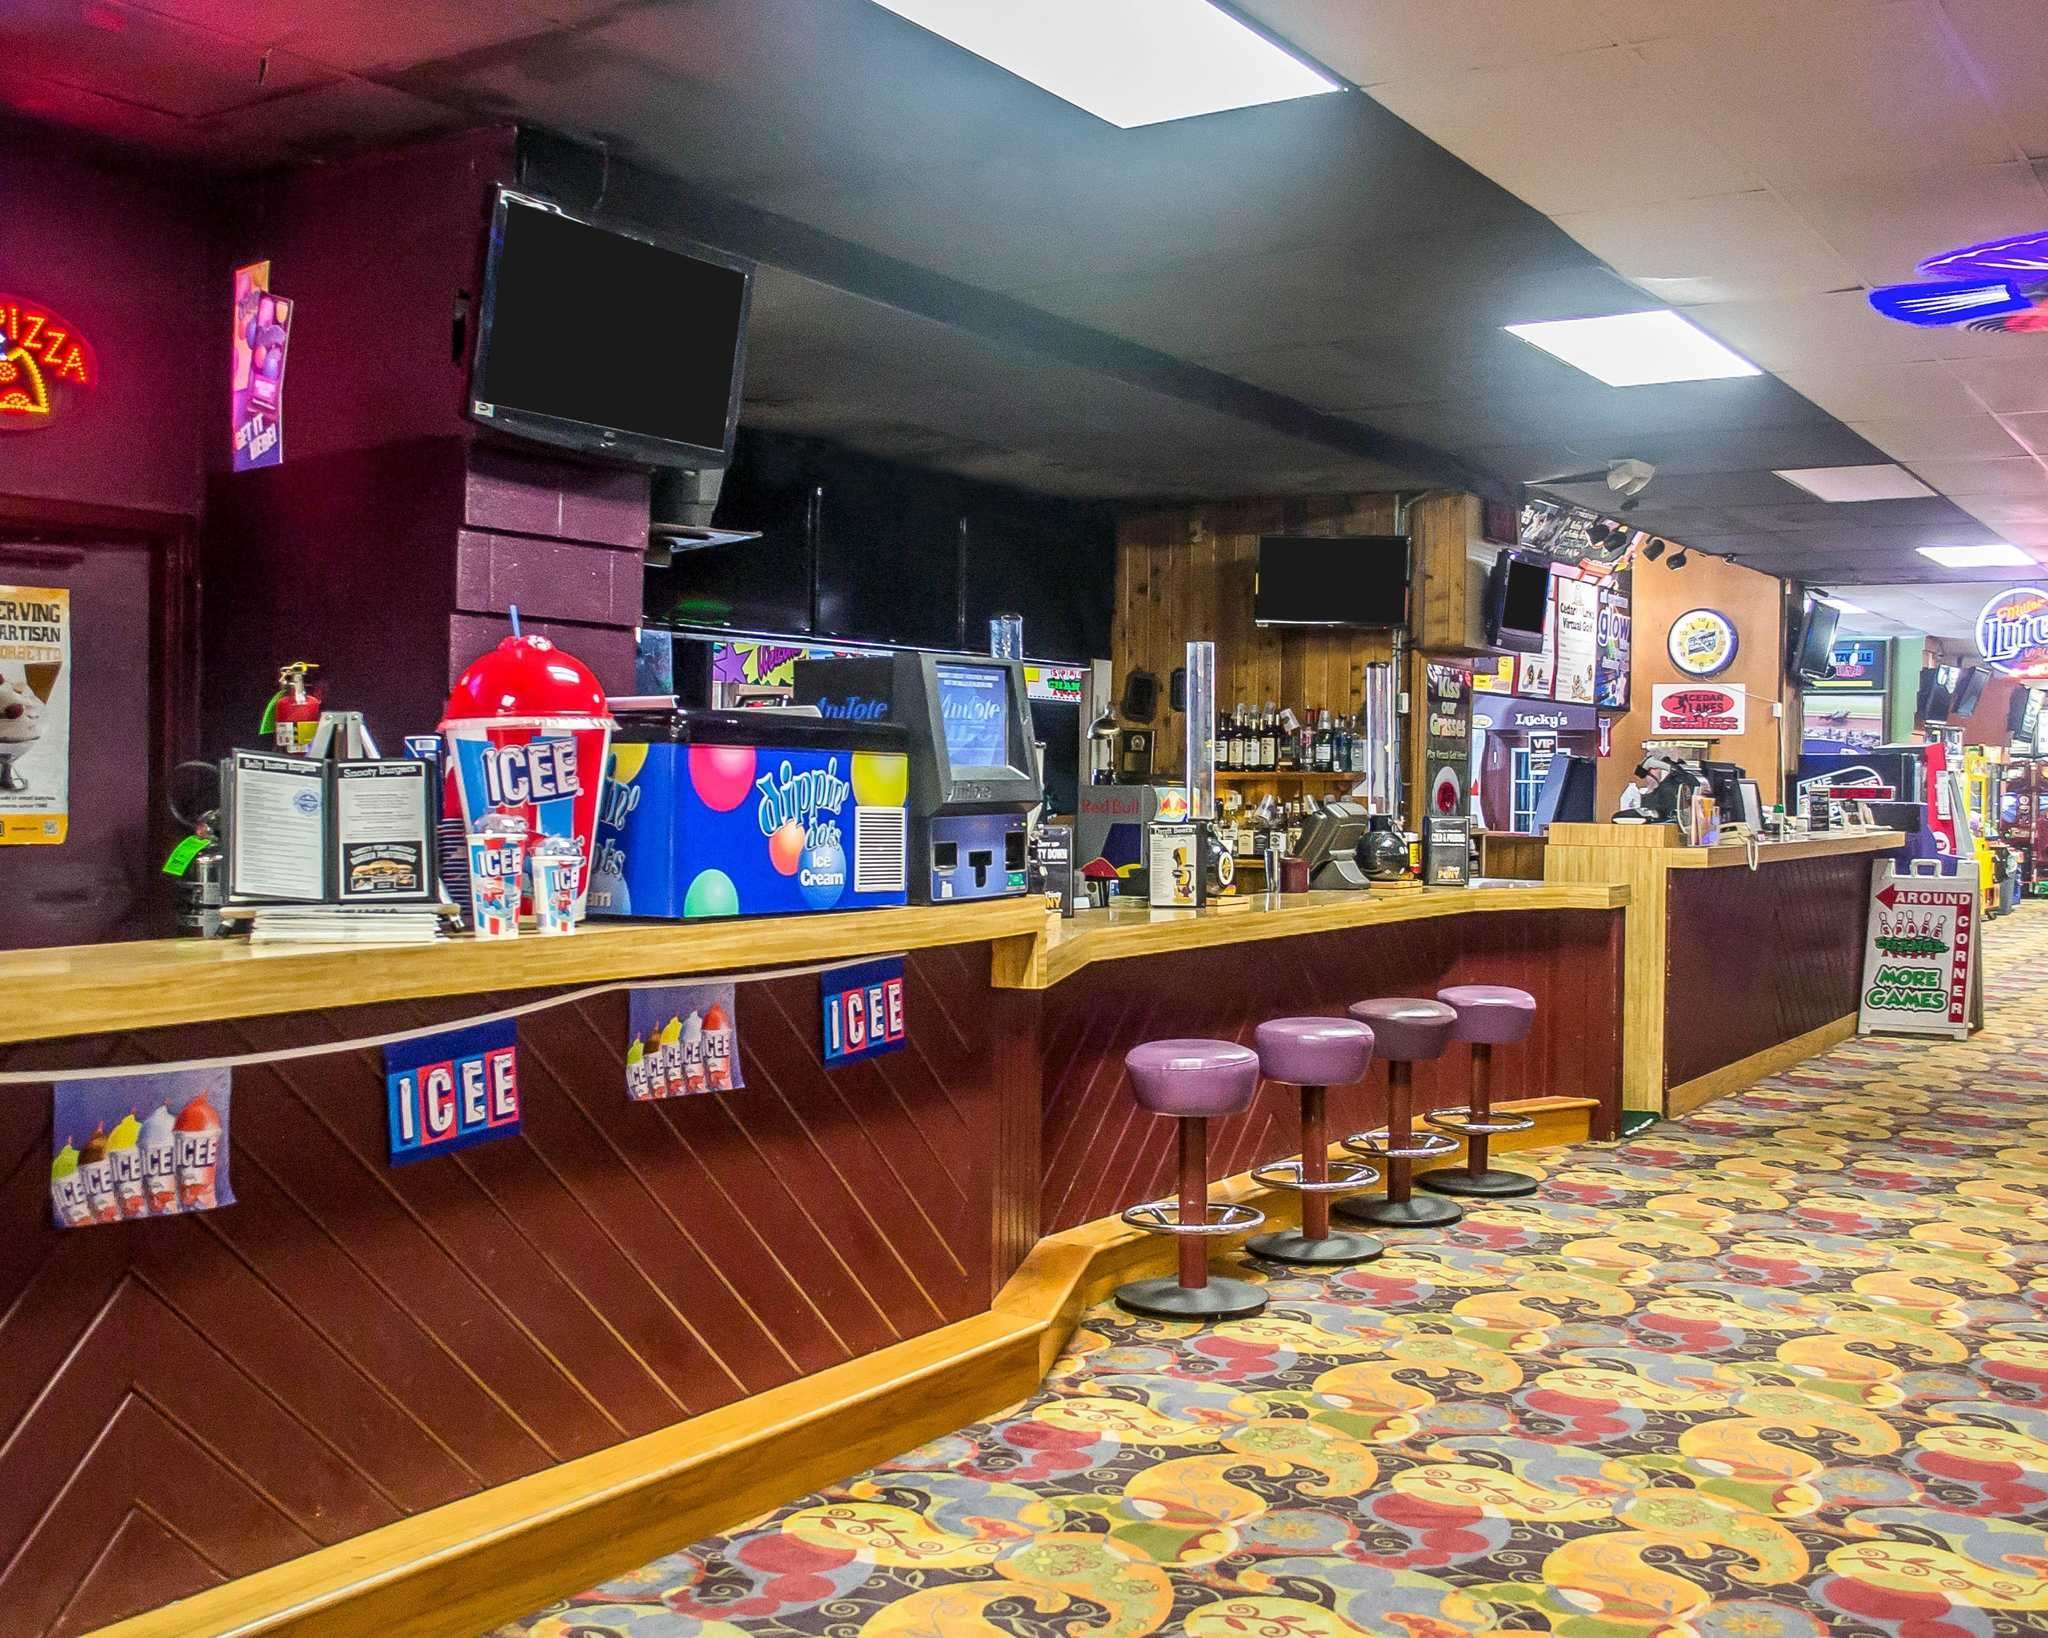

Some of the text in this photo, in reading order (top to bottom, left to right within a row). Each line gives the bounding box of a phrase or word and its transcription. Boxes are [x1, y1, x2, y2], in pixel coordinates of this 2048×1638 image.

[1598, 606, 1631, 648] glow
[1514, 711, 1569, 729] Lucky's
[1532, 738, 1555, 749] VIP
[482, 737, 578, 806] ICEE
[804, 816, 843, 851] dots
[811, 852, 832, 868] Ice
[800, 871, 844, 887] Cream
[1894, 891, 1971, 905] AROUND
[1877, 965, 1940, 988] MORE
[1950, 915, 1970, 1015] CORNER
[1867, 986, 1947, 1011] GAMES
[831, 982, 903, 1050] ICEE
[398, 1052, 518, 1141] ICEE
[175, 1136, 218, 1169] ICEE
